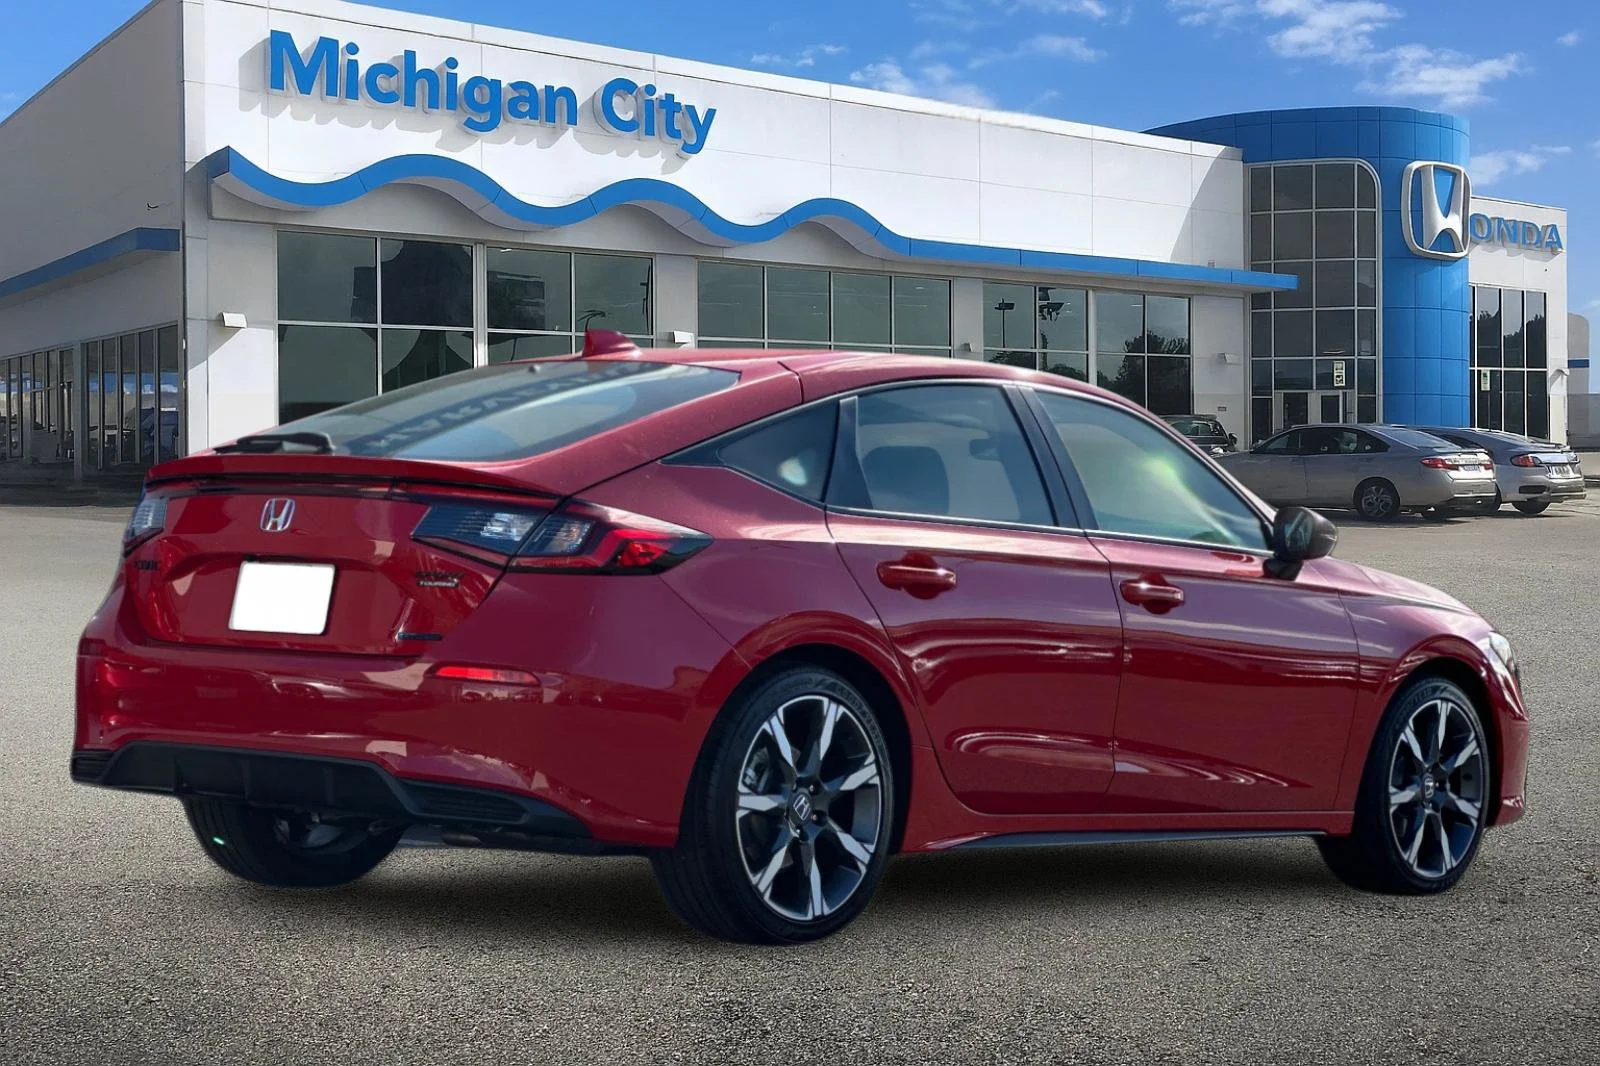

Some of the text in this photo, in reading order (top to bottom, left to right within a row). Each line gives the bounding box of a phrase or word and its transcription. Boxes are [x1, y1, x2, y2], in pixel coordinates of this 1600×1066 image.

[270, 29, 717, 154] Michigan City
[1469, 213, 1564, 249] ONDA
